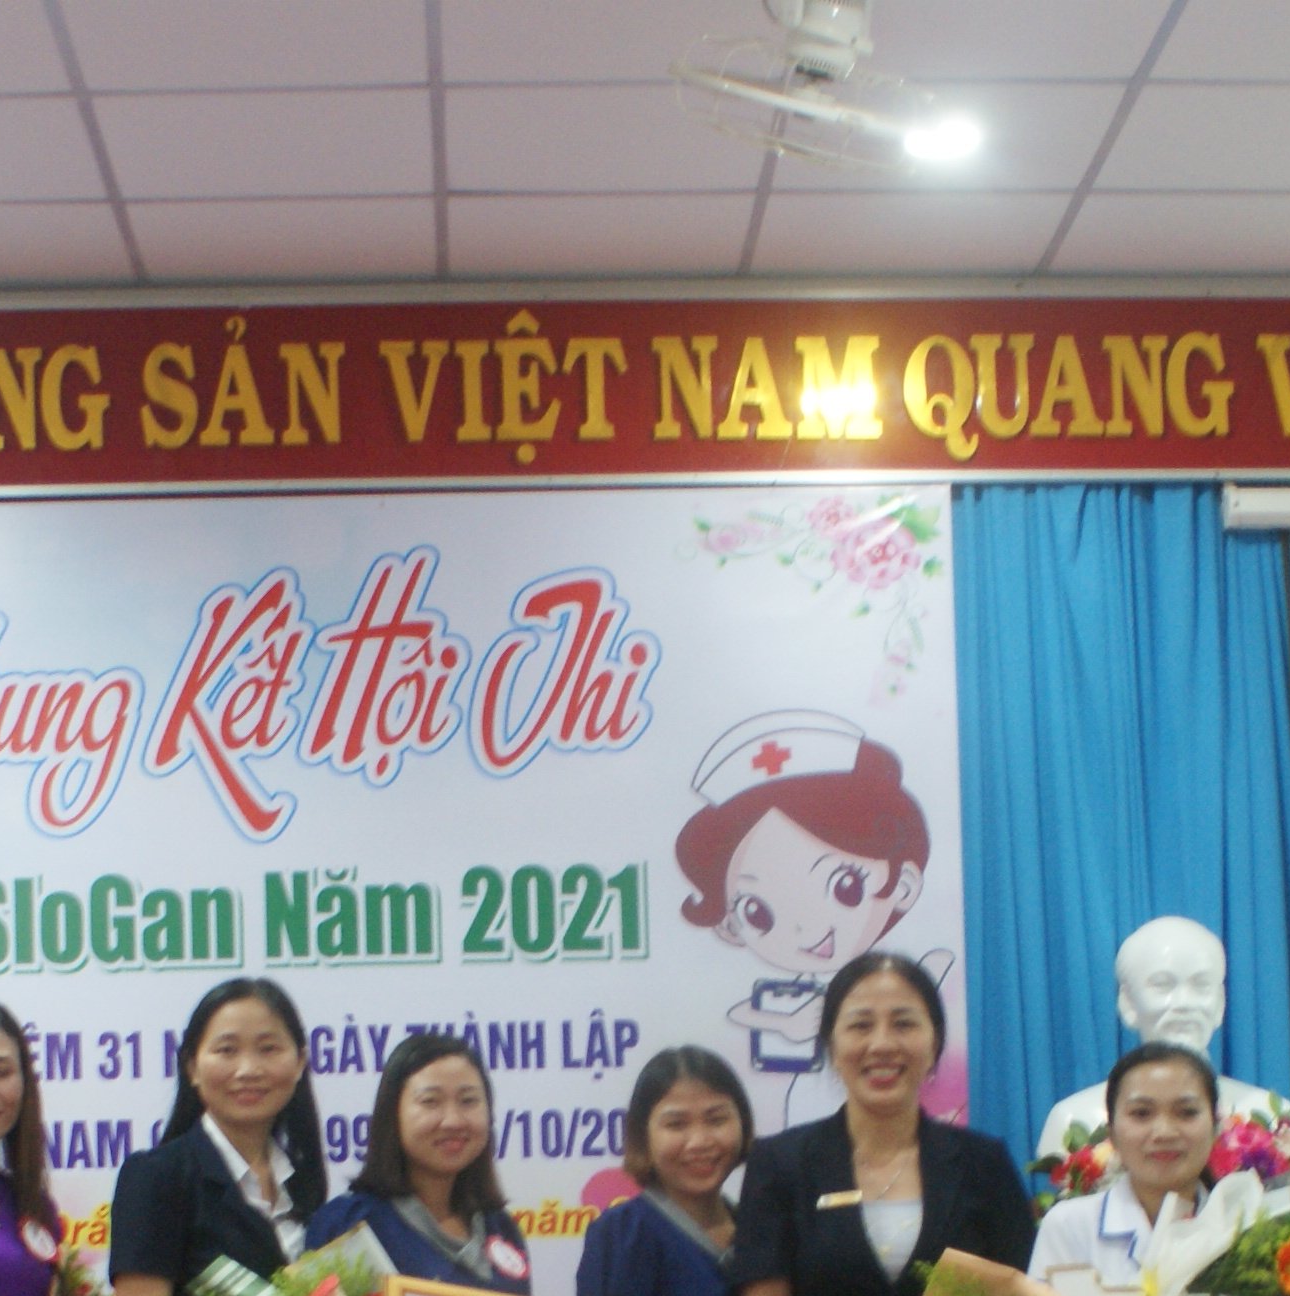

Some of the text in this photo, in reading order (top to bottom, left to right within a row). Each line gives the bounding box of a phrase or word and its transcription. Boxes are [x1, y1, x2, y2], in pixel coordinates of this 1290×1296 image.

[142, 317, 344, 450] SẢN
[381, 309, 629, 464] VIỆT
[653, 335, 883, 441] NAM
[904, 332, 1234, 460] QUANG
[155, 578, 303, 831] Kết
[311, 556, 458, 780] Hội
[481, 579, 649, 767] Thi
[265, 866, 436, 959] Năm
[462, 862, 644, 956] 2021
[98, 1031, 143, 1080] 31
[310, 1013, 392, 1075] GÀY
[561, 1008, 641, 1081] LẬP
